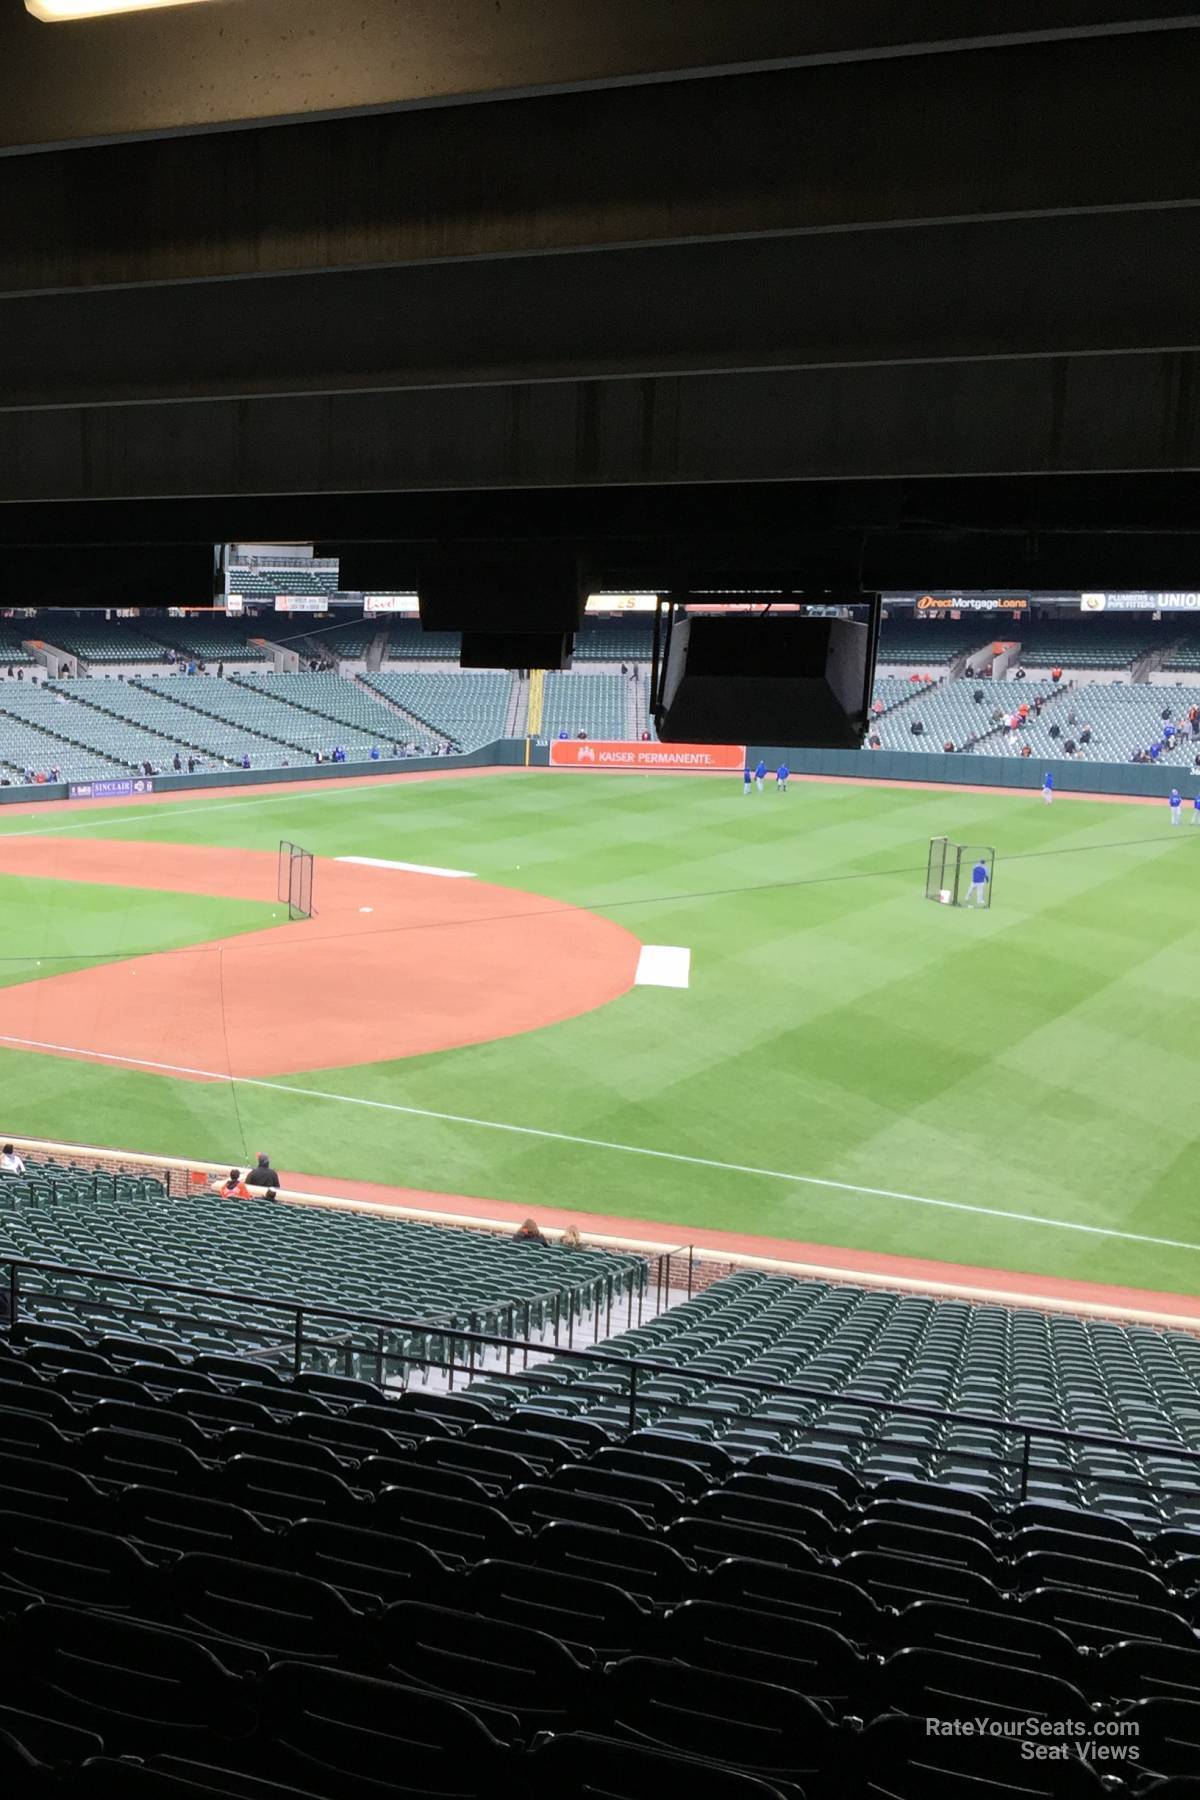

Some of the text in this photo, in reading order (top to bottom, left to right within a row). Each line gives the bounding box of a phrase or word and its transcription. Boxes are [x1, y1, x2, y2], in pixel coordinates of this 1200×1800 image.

[1158, 593, 1200, 607] UNIO
[598, 751, 712, 765] KAISER PERMANENTE
[95, 781, 131, 791] SINCLAIR
